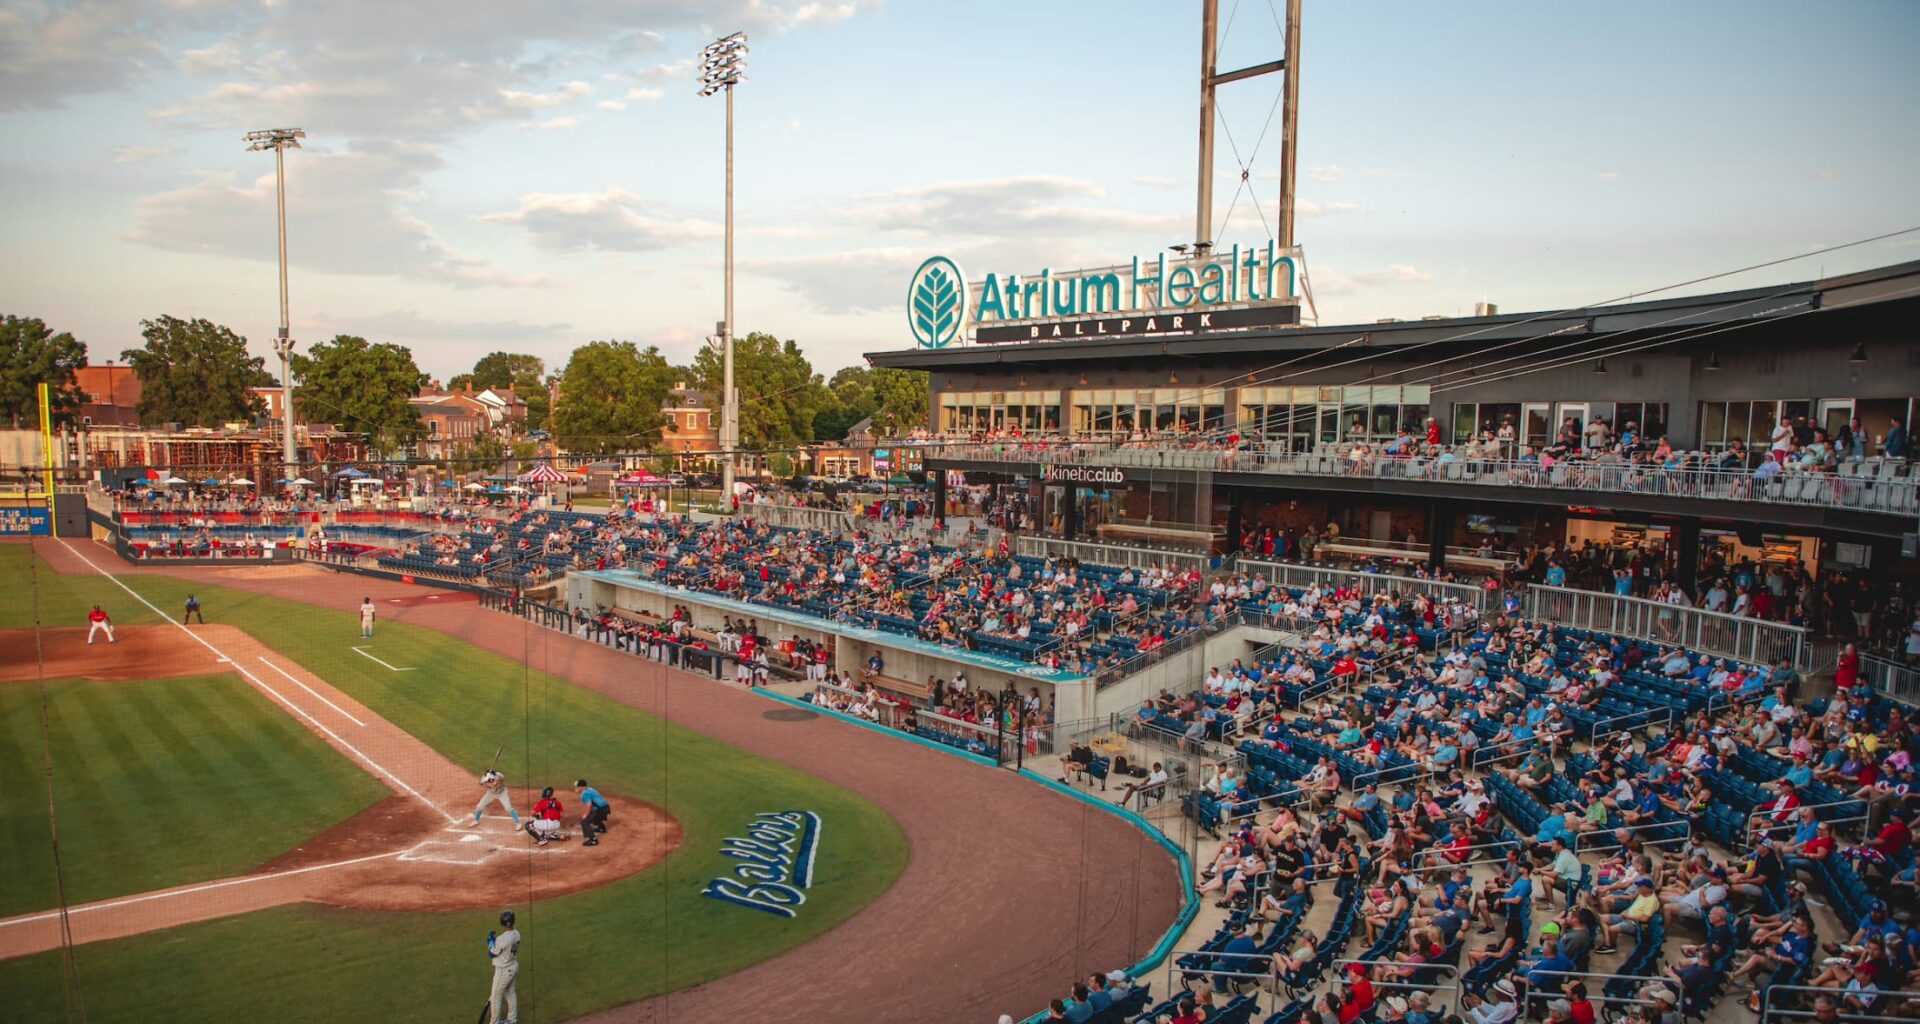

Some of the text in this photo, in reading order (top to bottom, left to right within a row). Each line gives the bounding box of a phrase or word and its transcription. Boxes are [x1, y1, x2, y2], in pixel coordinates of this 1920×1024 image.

[976, 239, 1297, 321] Atrium Health
[1030, 313, 1211, 338] BALLPARK
[9, 524, 31, 532] SIDE
[20, 517, 44, 525] FIRST
